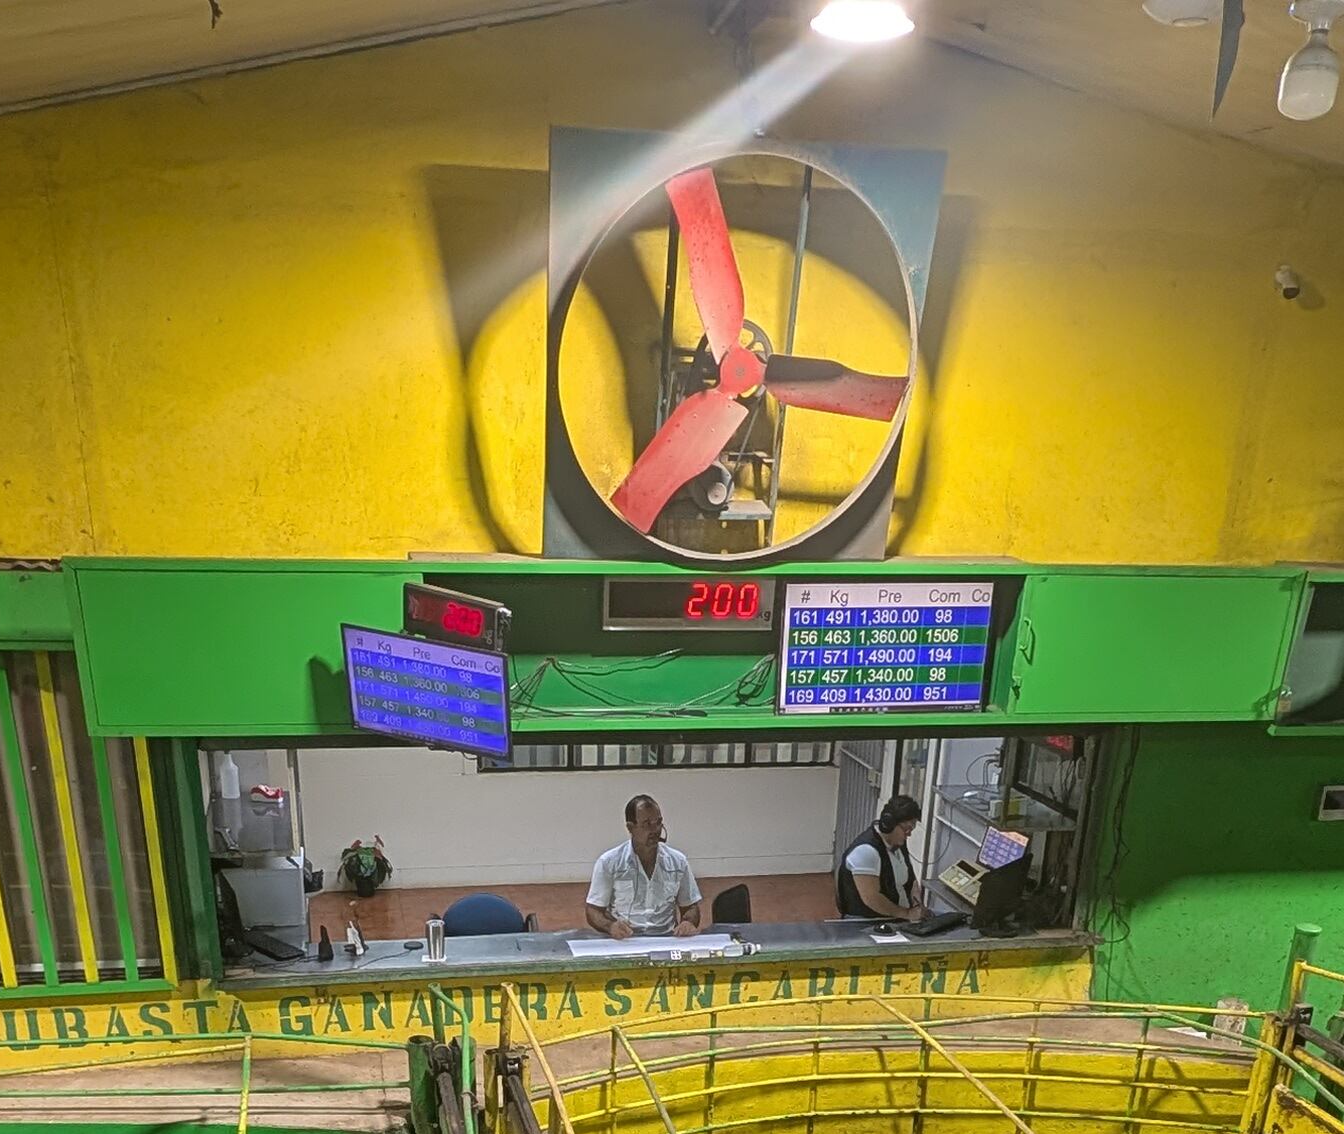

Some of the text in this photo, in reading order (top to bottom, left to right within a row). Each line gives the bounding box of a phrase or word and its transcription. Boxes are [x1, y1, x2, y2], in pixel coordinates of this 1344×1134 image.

[687, 583, 758, 617] 200
[801, 588, 990, 607] # Kg Pre Com Co
[793, 609, 952, 626] 161 491 1,380.00 98
[792, 629, 959, 646] 156 463 1,360.00 1506
[377, 641, 392, 654] Kg
[413, 647, 431, 660] Pre
[451, 655, 477, 670] Com
[791, 648, 952, 665] 171 571 1,490.00 194
[379, 671, 398, 683] 463
[790, 668, 946, 684] 157 457 1,340.00 98
[788, 687, 947, 704] 169 409 1,430.00 951
[462, 716, 475, 728] 98
